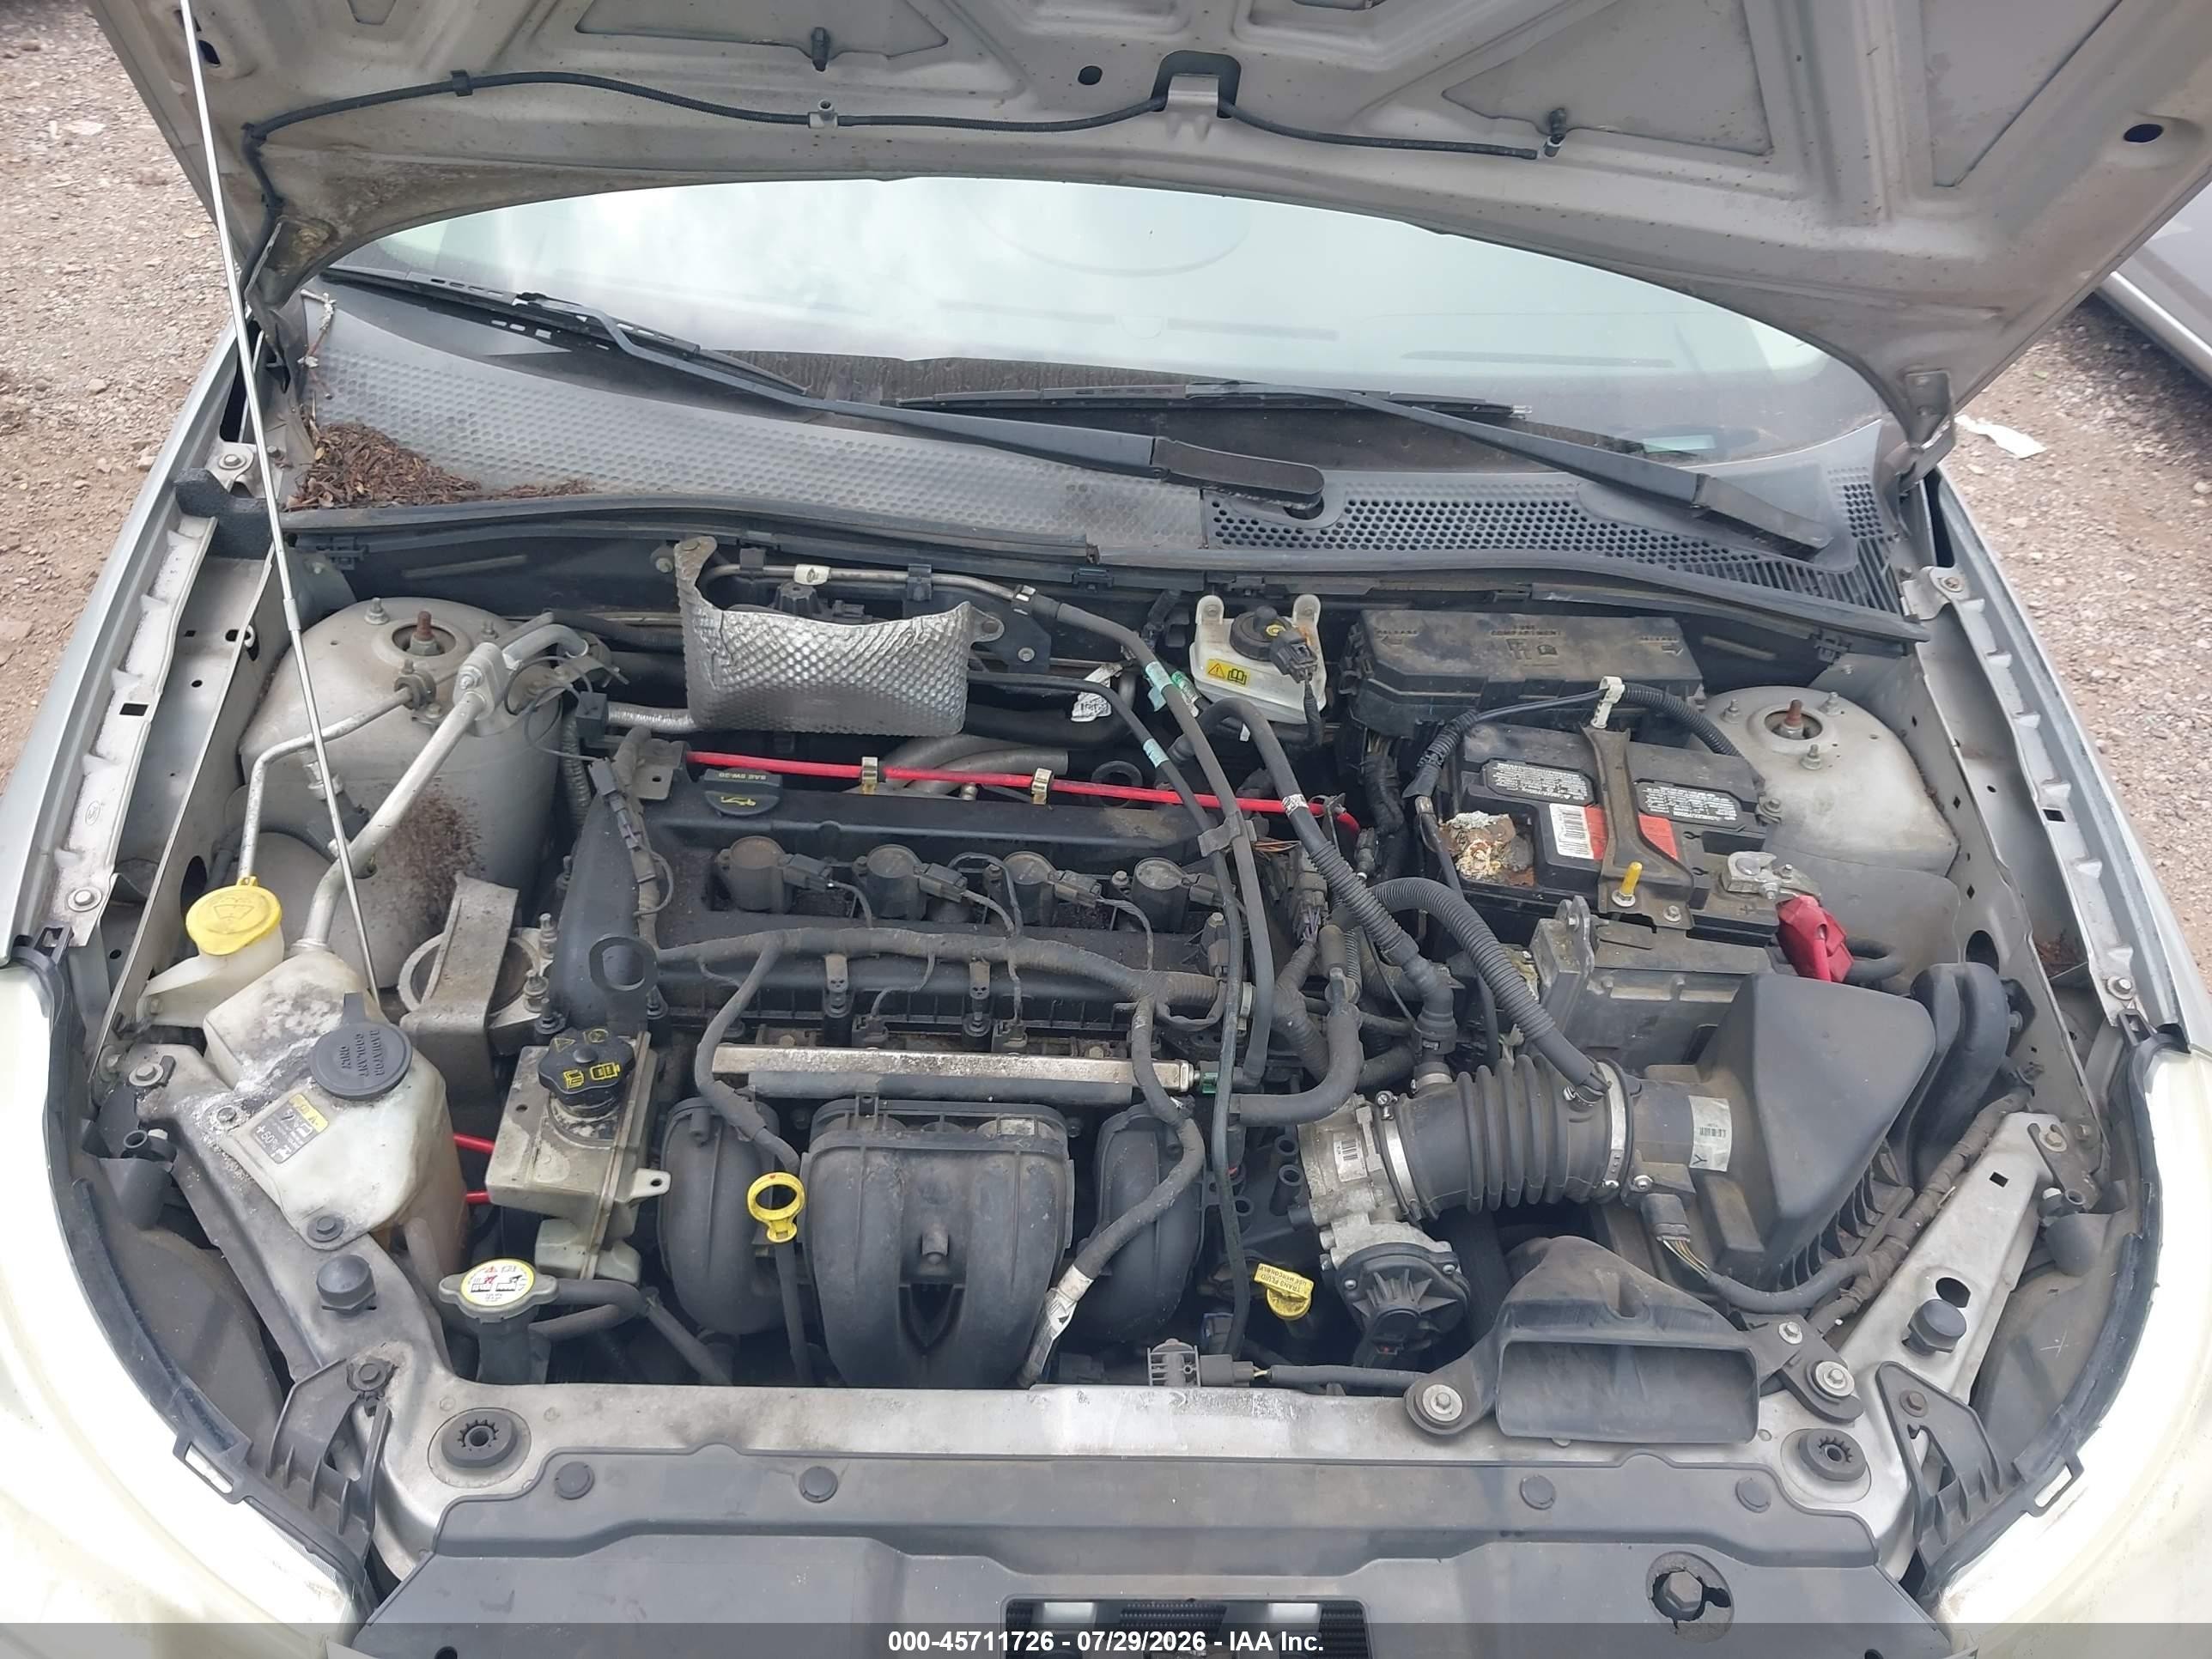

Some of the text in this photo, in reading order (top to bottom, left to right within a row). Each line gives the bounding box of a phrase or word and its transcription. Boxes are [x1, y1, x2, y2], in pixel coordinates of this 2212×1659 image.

[339, 1045, 351, 1070] ONLY
[355, 1033, 368, 1078] COOLANT
[370, 1030, 385, 1077] RADIATOR
[1280, 1280, 1301, 1293] TRANS
